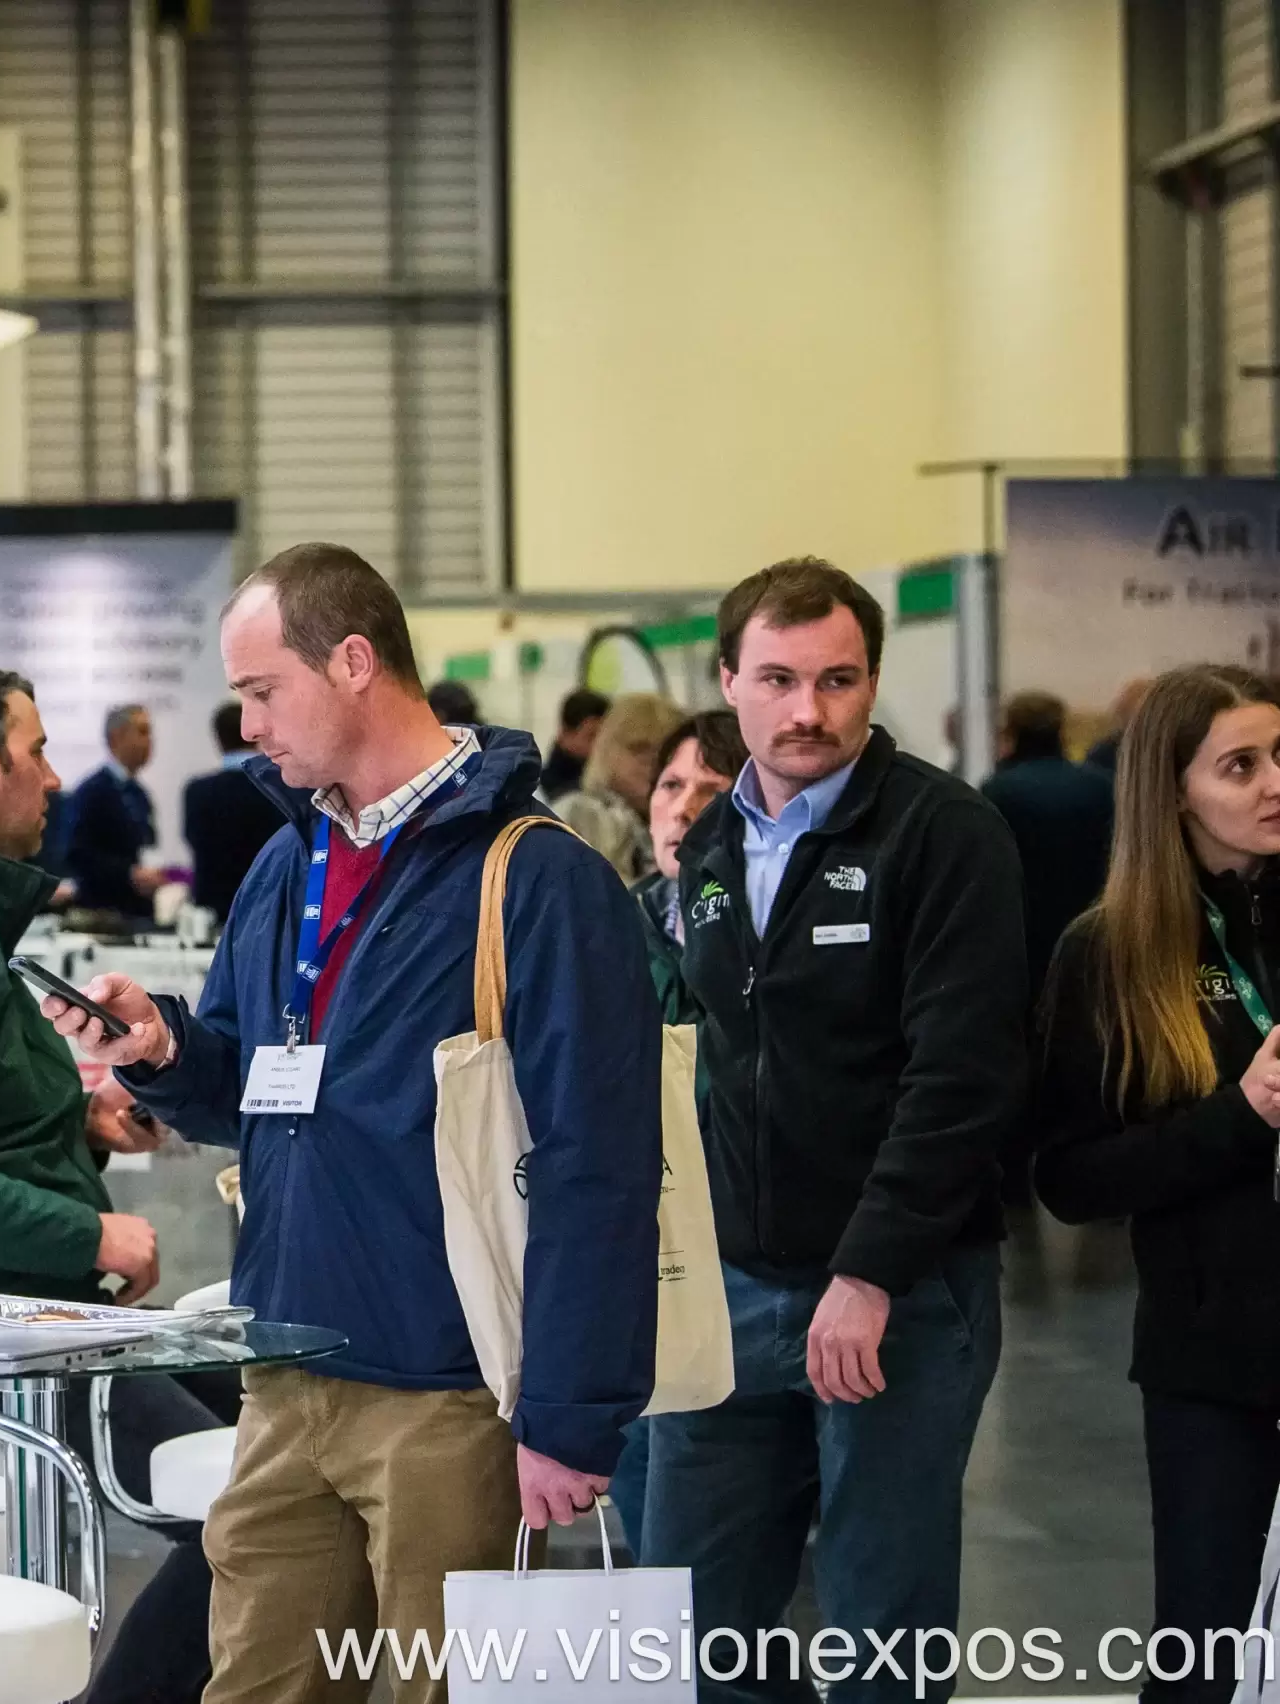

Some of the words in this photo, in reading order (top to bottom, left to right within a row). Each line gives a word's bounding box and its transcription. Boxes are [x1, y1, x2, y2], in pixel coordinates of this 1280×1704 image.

[839, 865, 855, 875] THE
[824, 871, 854, 881] NORTH
[829, 880, 852, 890] FACE
